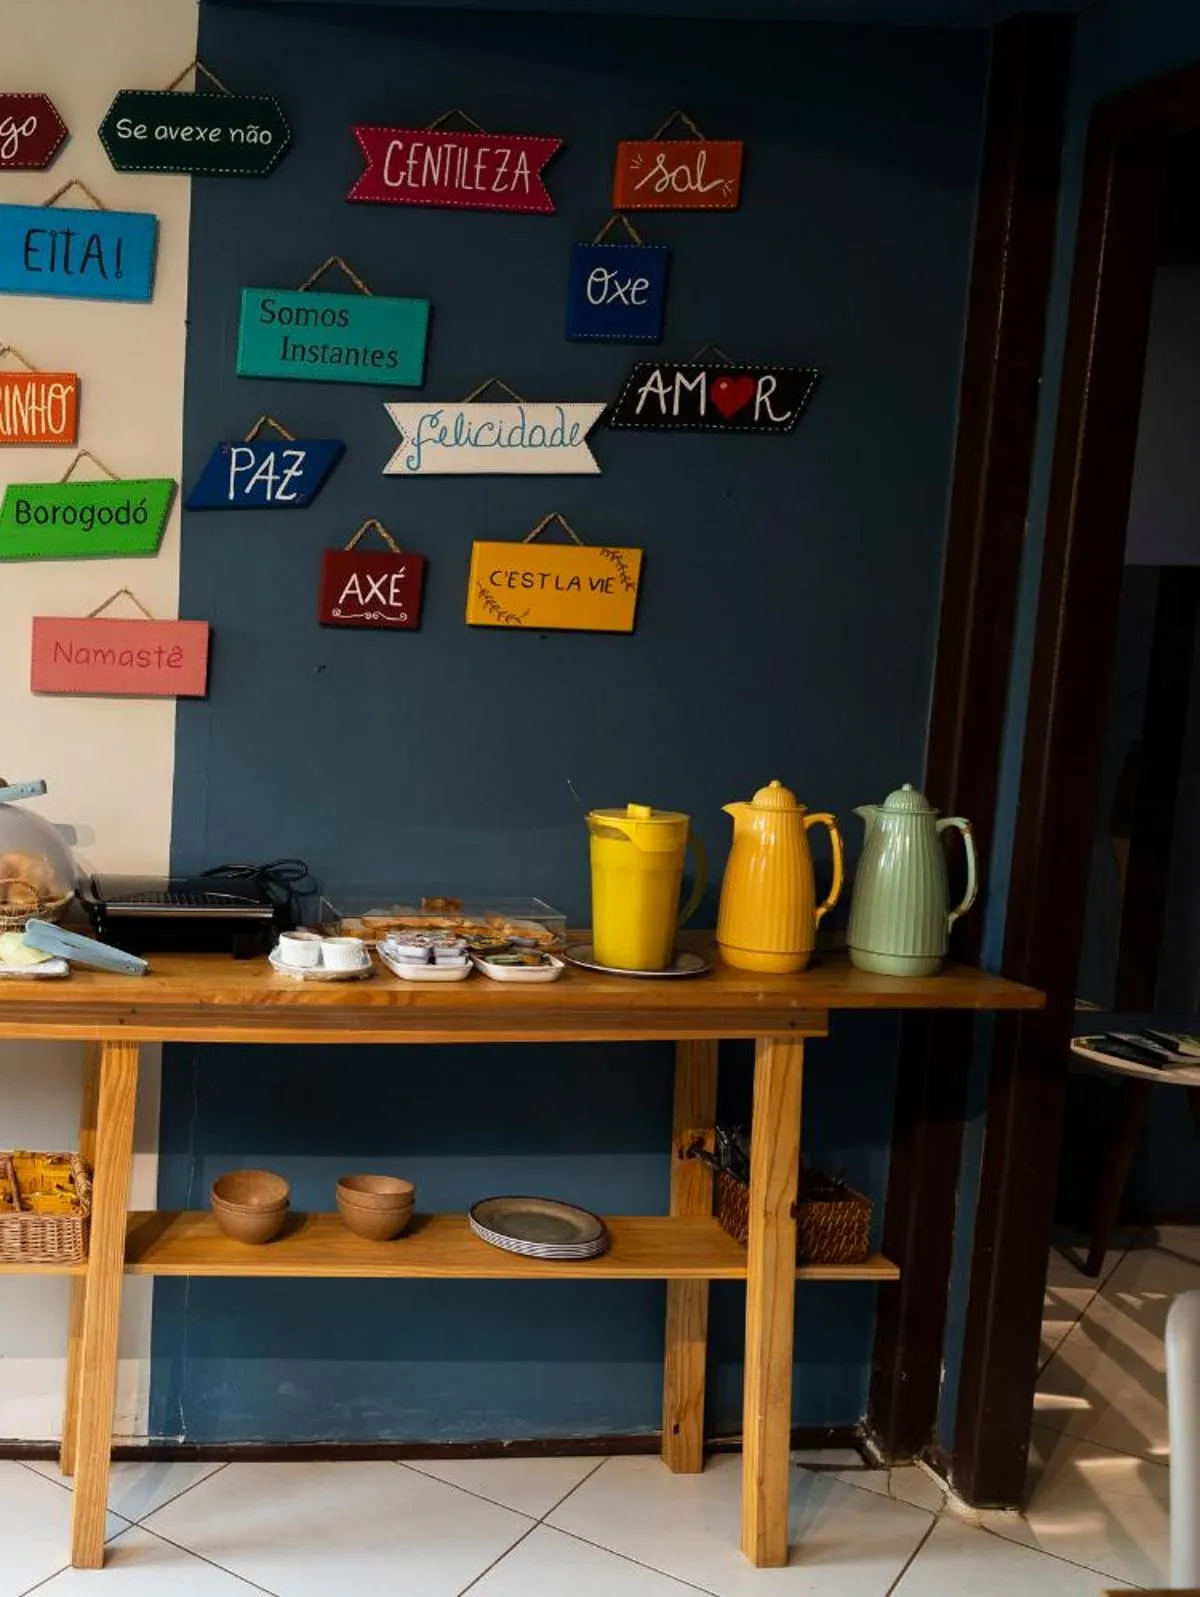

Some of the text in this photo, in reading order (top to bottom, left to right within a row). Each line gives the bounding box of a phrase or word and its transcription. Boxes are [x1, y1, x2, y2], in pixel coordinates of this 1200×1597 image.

[116, 117, 273, 145] Se avexe não
[383, 140, 531, 194] GENTILEZA
[260, 299, 349, 328] Somos
[279, 335, 399, 370] Instantes
[228, 447, 307, 500] PAZ
[14, 498, 149, 534] Borogodó
[338, 566, 407, 607] AXÉ
[489, 570, 615, 594] C'EST LA VIE
[53, 640, 185, 670] Namastê
